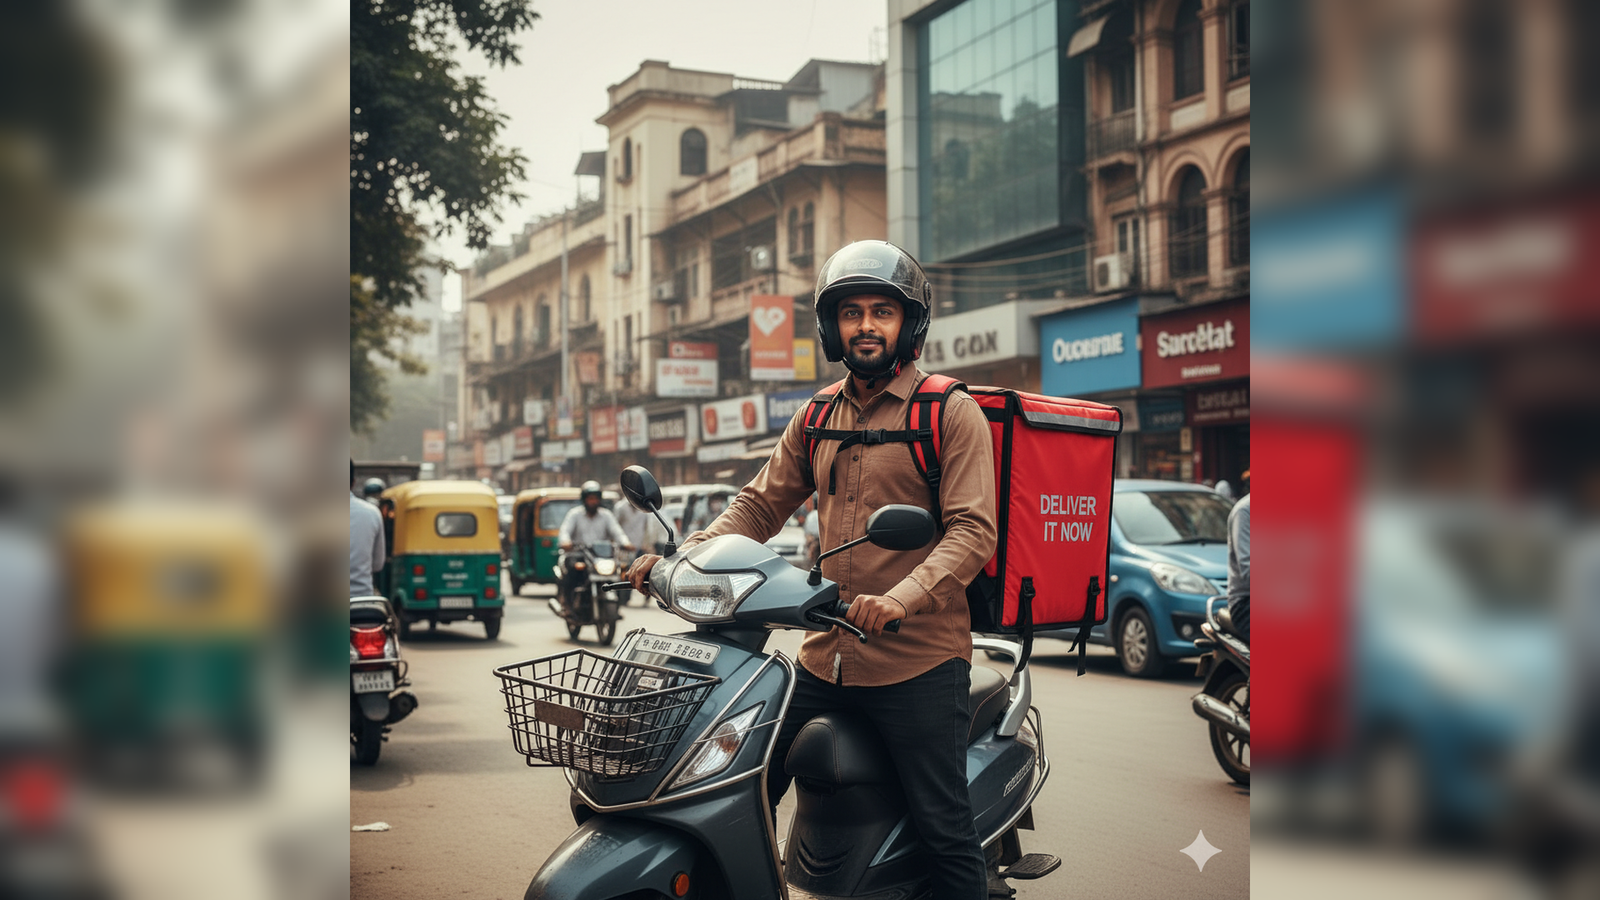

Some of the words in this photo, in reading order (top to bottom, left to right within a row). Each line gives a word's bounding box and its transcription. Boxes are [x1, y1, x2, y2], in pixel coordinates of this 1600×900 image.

[1040, 494, 1097, 515] DELIVER
[1044, 521, 1058, 541] IT
[1060, 521, 1093, 542] NOW
